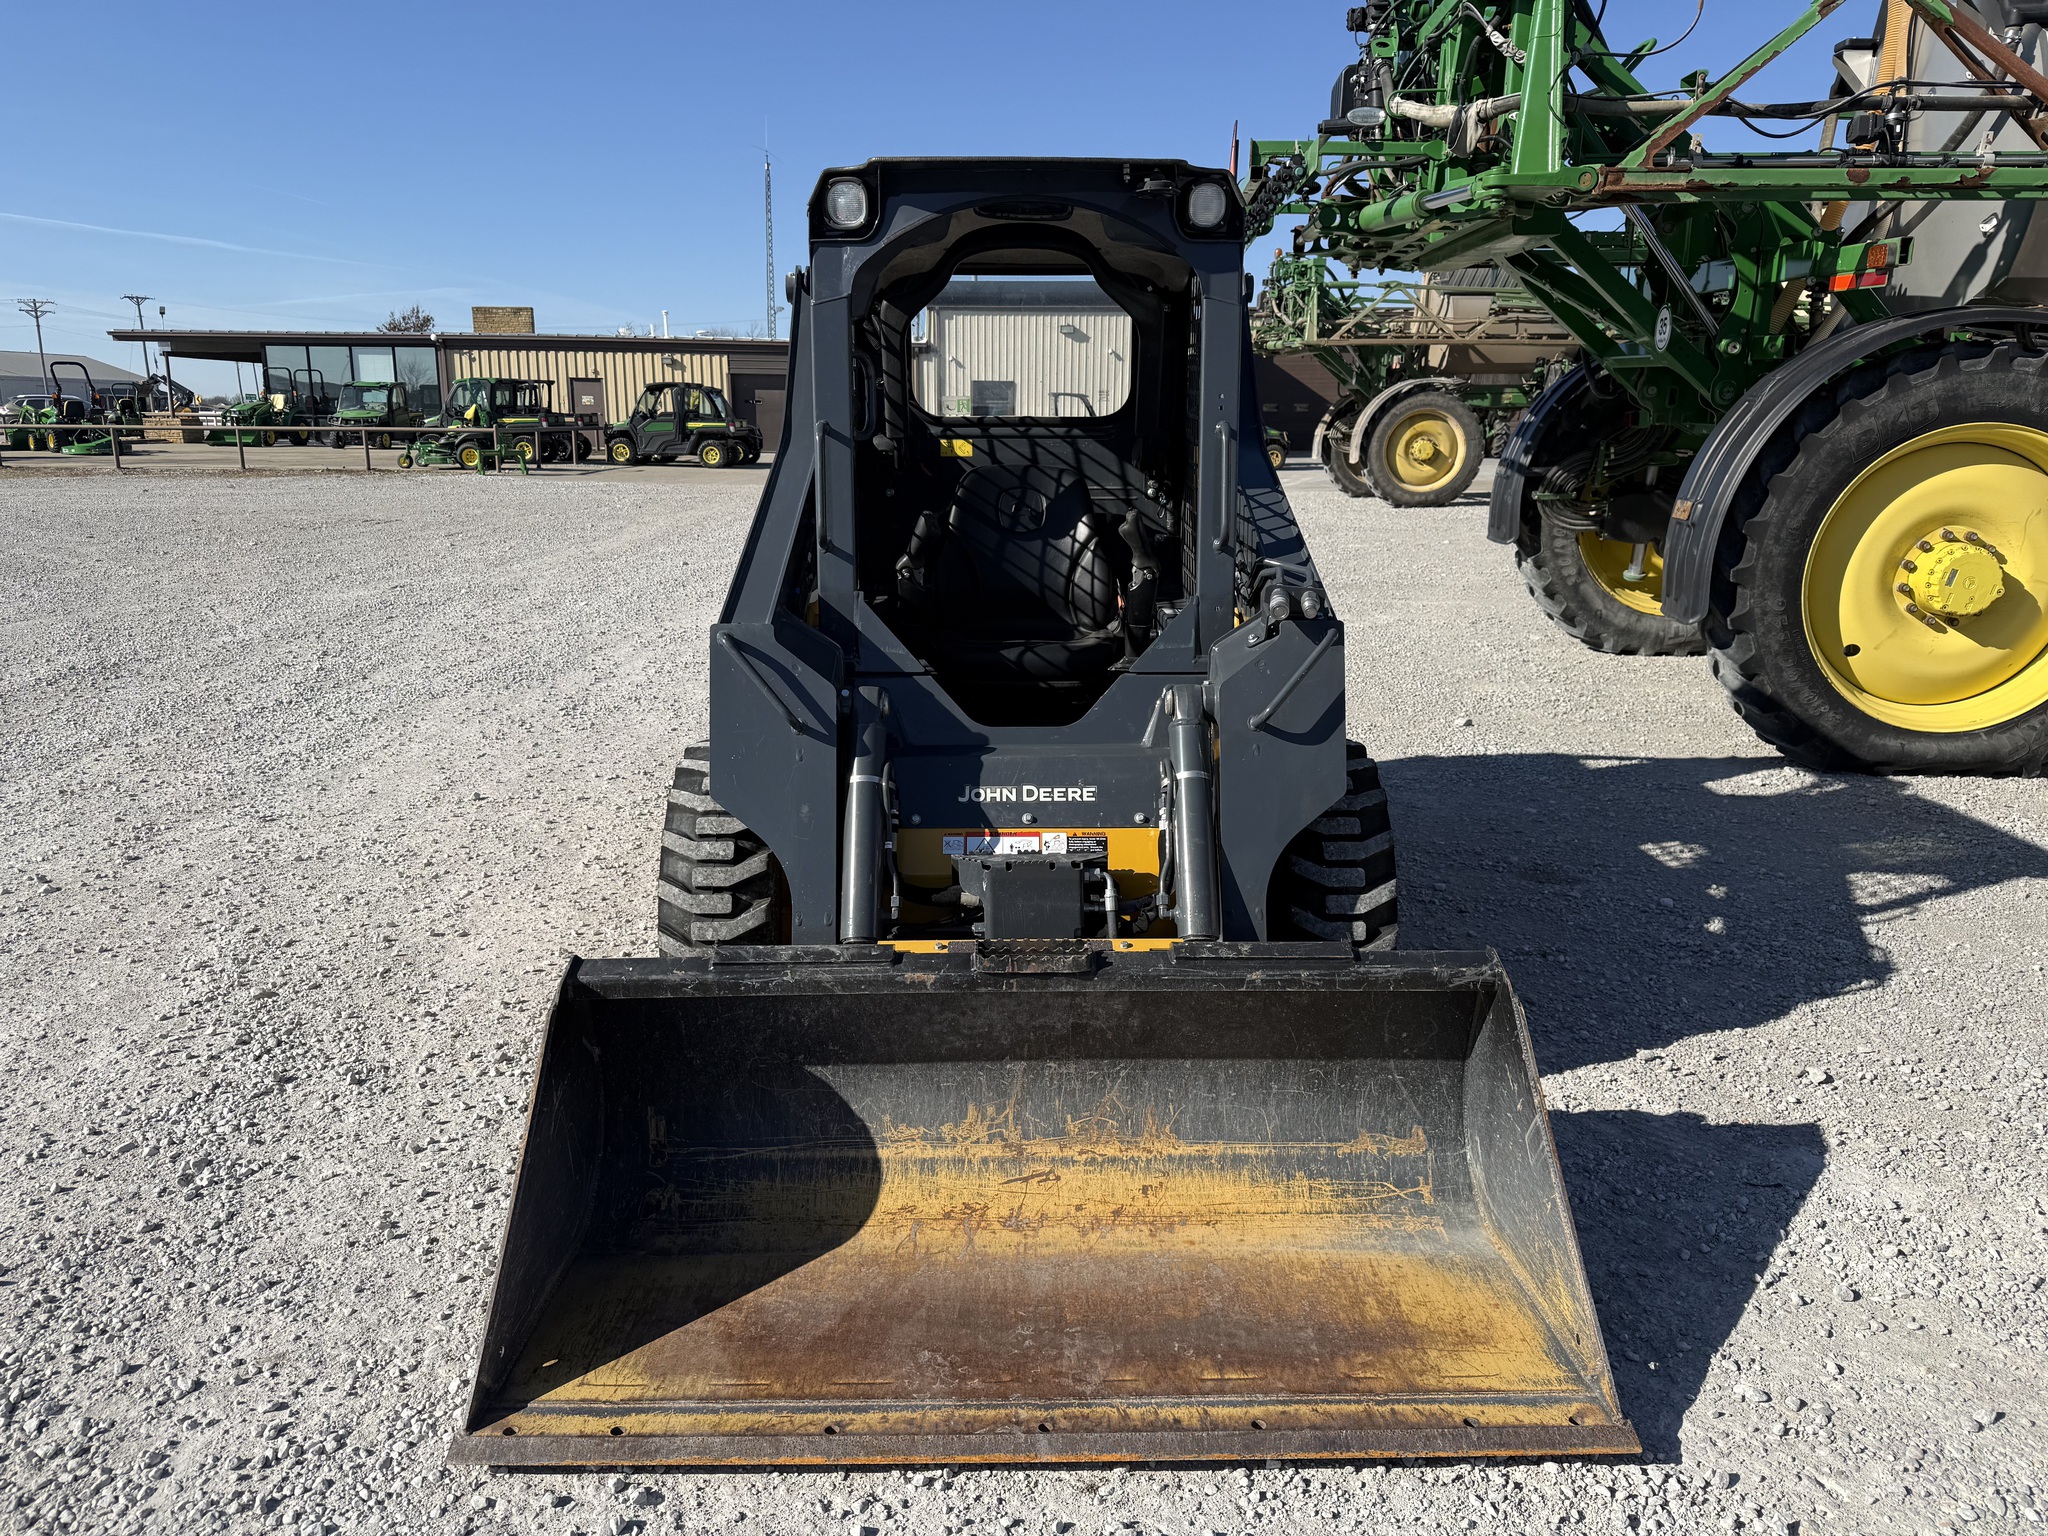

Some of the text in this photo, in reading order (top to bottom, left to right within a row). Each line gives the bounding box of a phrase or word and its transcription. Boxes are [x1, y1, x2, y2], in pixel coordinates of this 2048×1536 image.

[1659, 317, 1668, 335] 35
[958, 784, 1097, 802] JOHN DEERE
